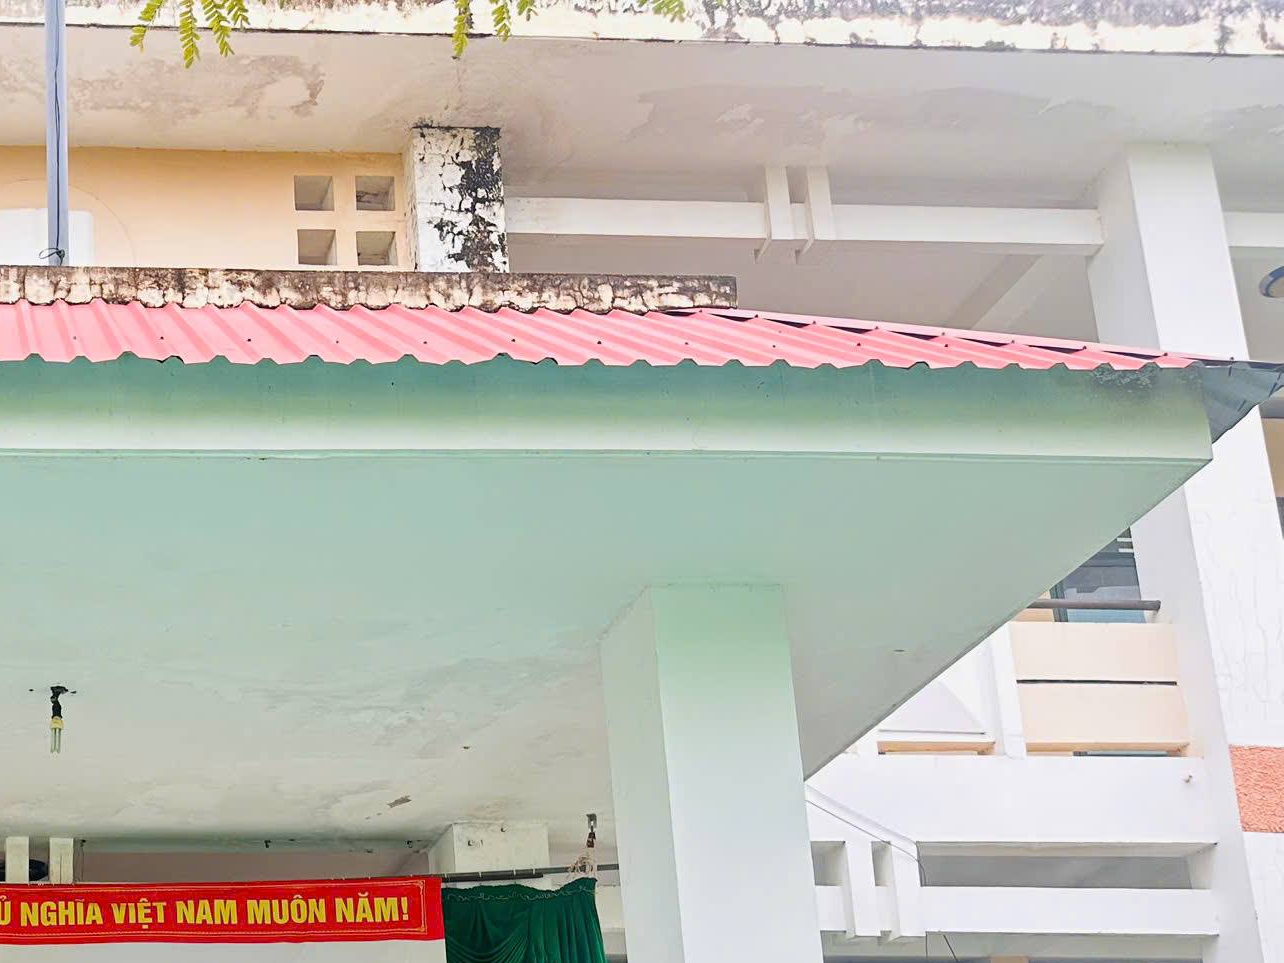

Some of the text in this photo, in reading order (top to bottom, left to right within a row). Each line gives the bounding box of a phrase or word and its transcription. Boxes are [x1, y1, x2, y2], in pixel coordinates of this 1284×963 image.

[20, 898, 103, 927] NGHĨA
[110, 897, 167, 930] VIỆT
[176, 899, 238, 925] NAM
[246, 894, 327, 925] MUÔN
[334, 891, 409, 924] NĂM!
